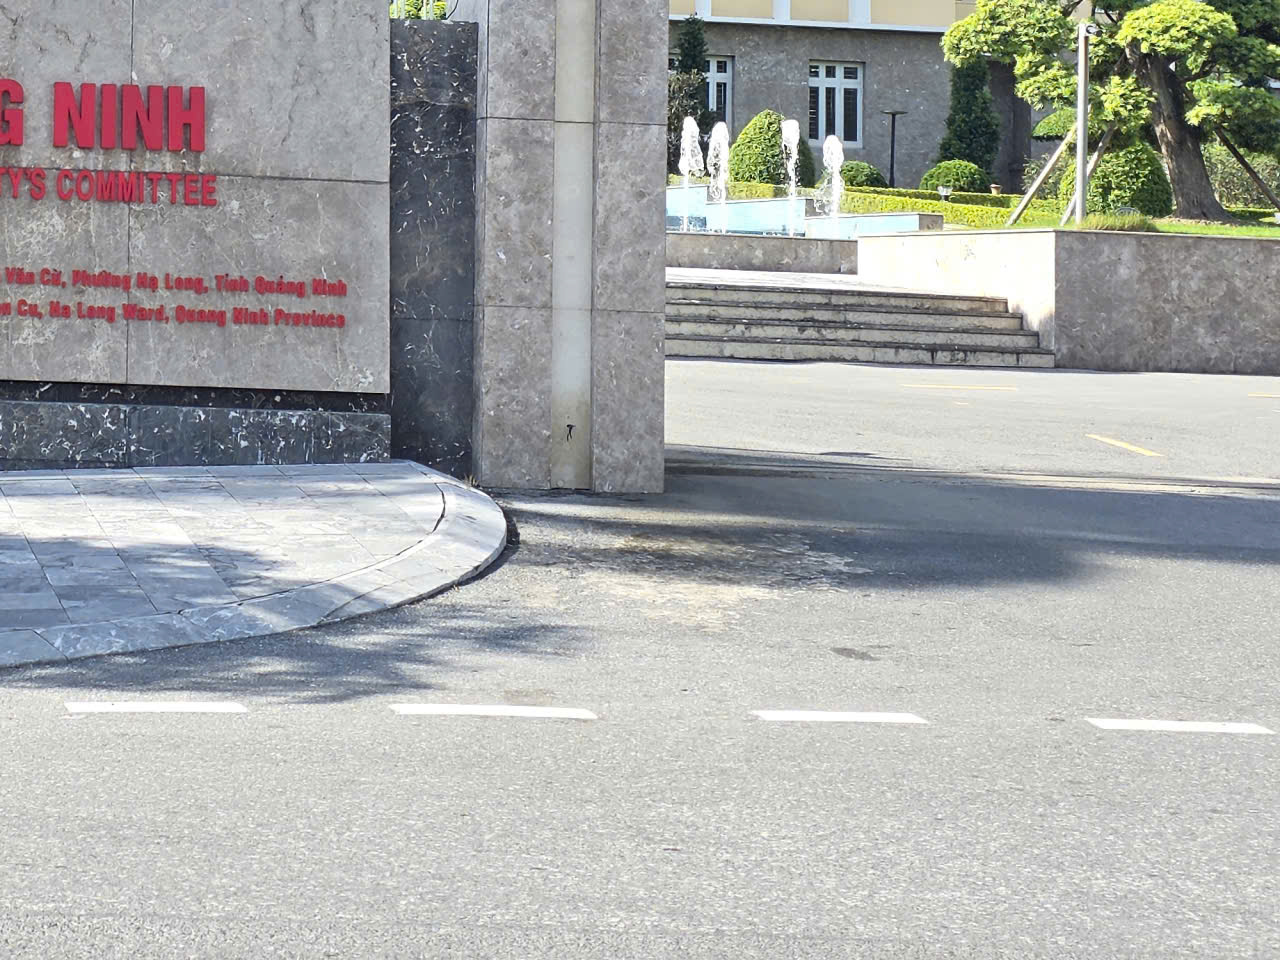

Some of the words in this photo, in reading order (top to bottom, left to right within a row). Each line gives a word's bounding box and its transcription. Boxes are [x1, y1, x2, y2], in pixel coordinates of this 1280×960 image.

[52, 80, 206, 153] NINH
[56, 169, 218, 207] COMMITTEE
[5, 266, 36, 285] Văn
[40, 267, 67, 289] Cừ,
[165, 273, 209, 295] Long,
[255, 275, 306, 299] Quảng
[312, 278, 348, 297] Ninh
[17, 298, 43, 320] Cu,
[49, 300, 71, 319] Ha
[77, 301, 116, 324] Long
[122, 303, 170, 325] Ward,
[175, 304, 227, 328] Quang
[233, 306, 269, 326] Ninh
[274, 308, 346, 329] Province
